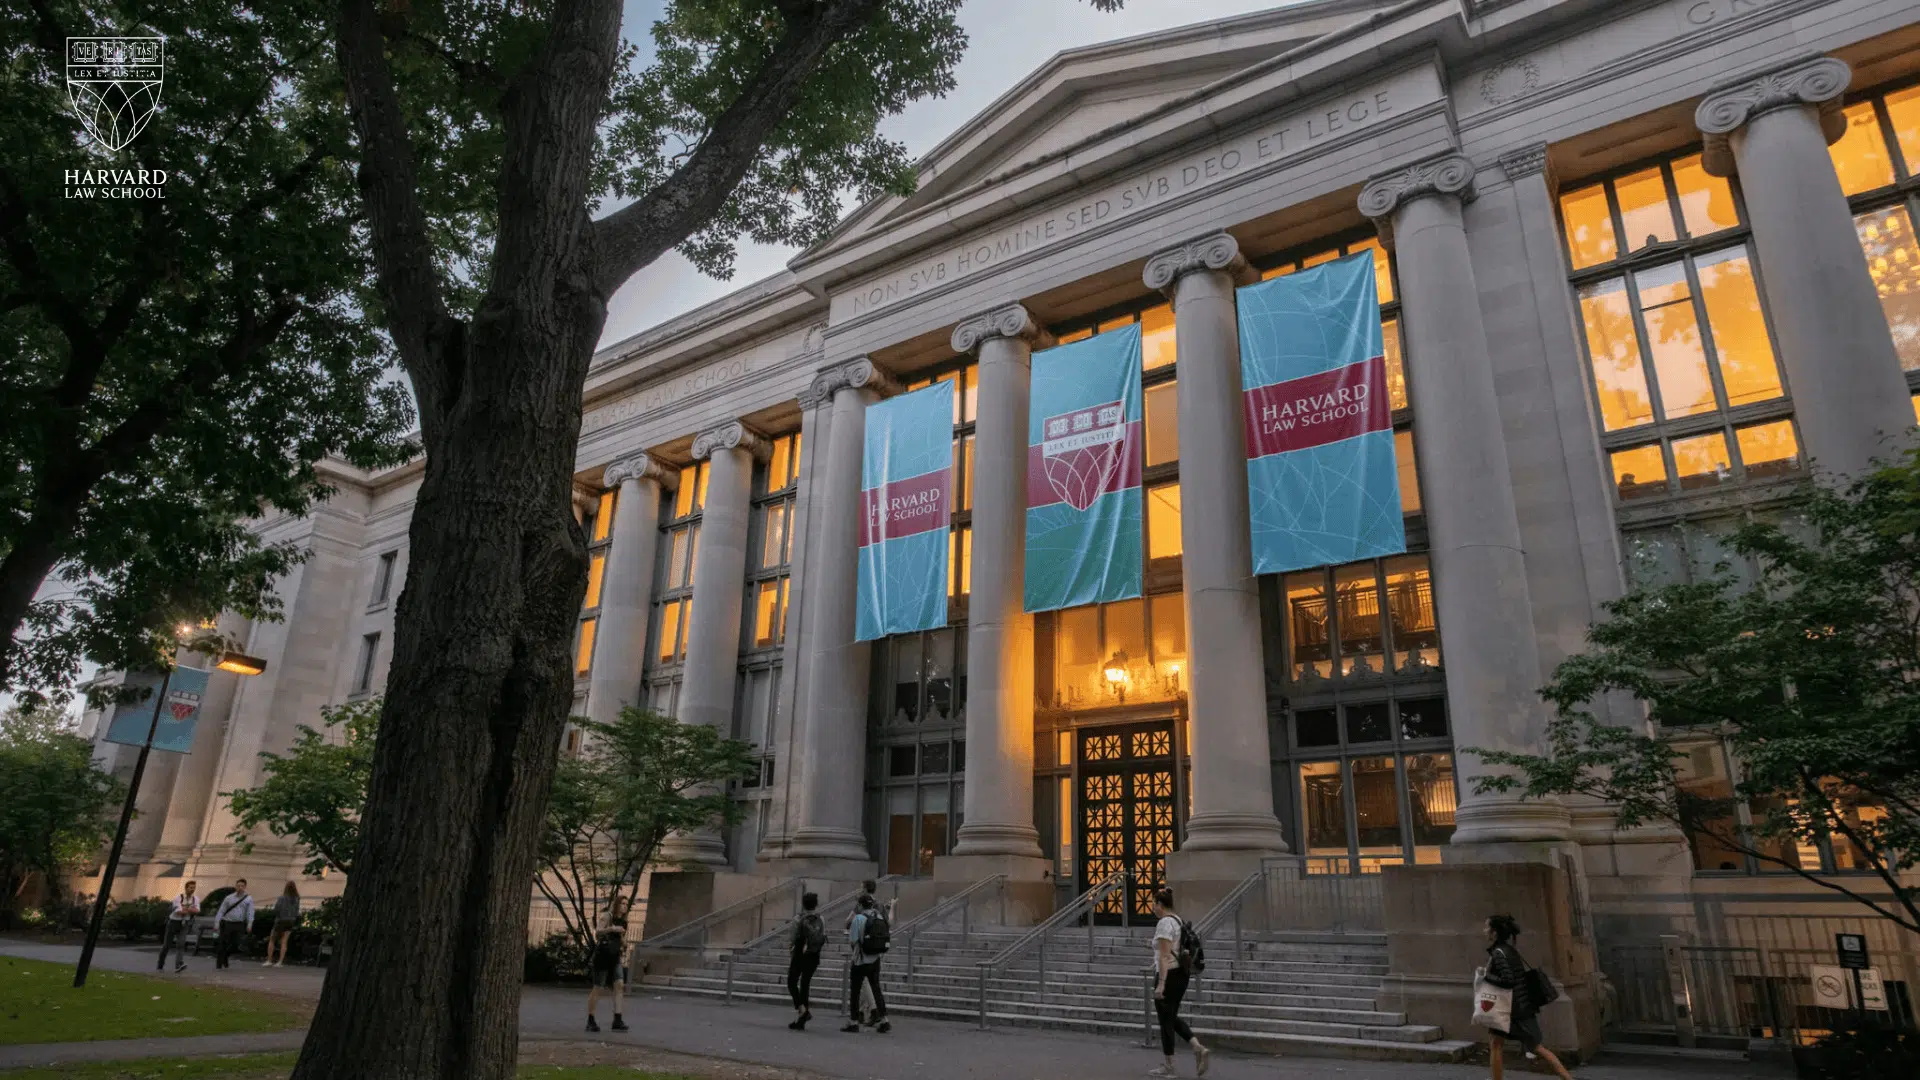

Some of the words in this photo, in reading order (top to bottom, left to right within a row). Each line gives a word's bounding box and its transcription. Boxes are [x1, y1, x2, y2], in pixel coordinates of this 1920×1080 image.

[853, 280, 900, 314] NON
[908, 262, 946, 292] SVB
[957, 219, 1056, 273] HOMINE
[1065, 199, 1111, 232] SED
[1121, 176, 1170, 210] SVB
[1182, 149, 1241, 187] DEO
[1256, 128, 1291, 160] ET
[1306, 90, 1393, 141] LEGE
[683, 357, 751, 396] SCHOOL
[1262, 383, 1369, 422] HARVARD
[1263, 418, 1297, 435] LAW
[1301, 401, 1369, 428] SCHOOL
[893, 502, 939, 521] SCHOOL
